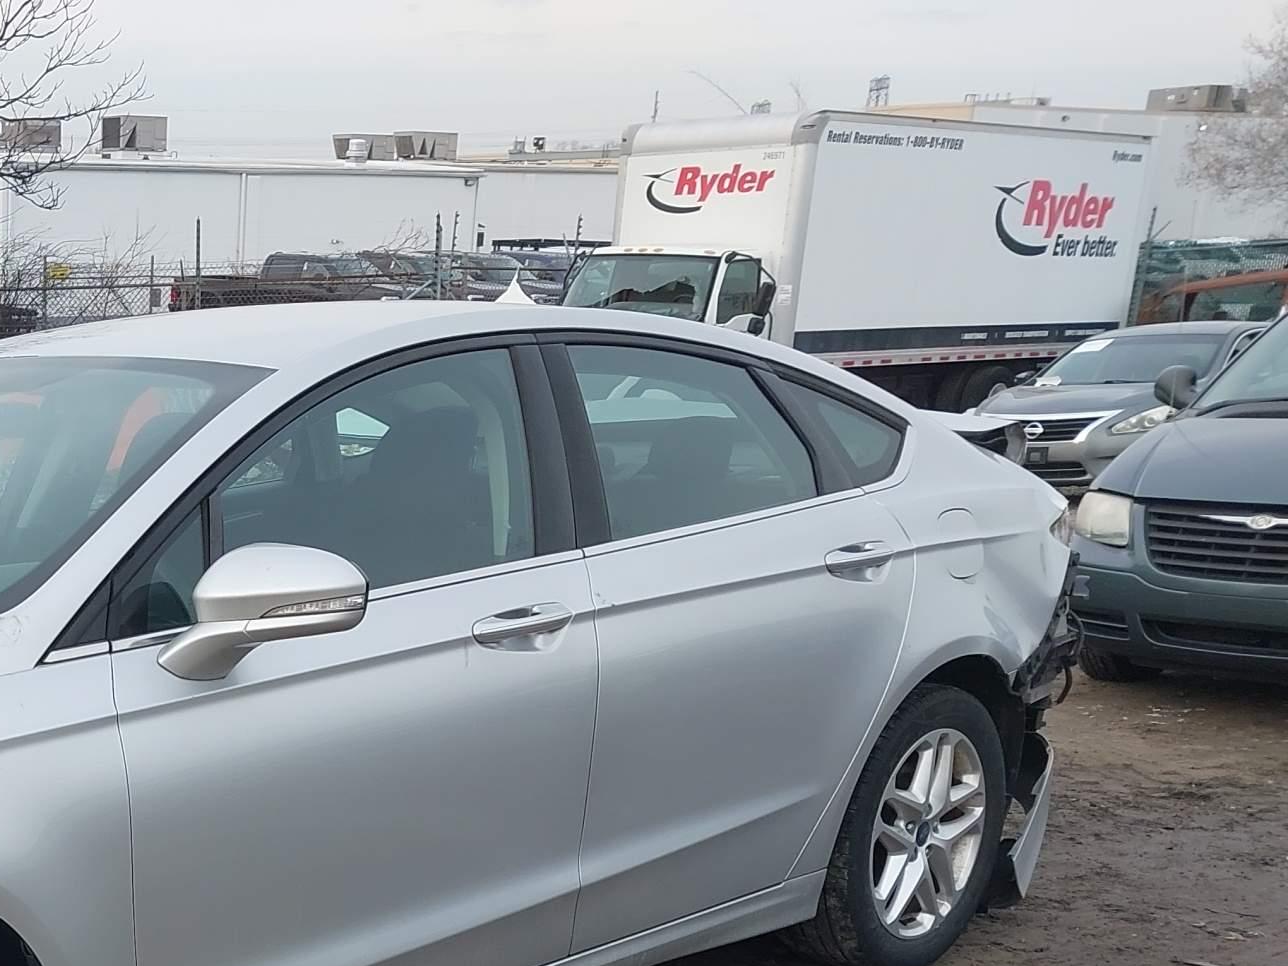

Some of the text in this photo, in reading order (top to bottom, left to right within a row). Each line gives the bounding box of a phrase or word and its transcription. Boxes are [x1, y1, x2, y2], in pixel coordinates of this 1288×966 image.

[827, 130, 853, 143] Rental
[853, 131, 904, 146] Reservations:
[674, 163, 776, 202] Ryder
[1022, 180, 1115, 238] Ryder
[1052, 233, 1081, 257] Ever
